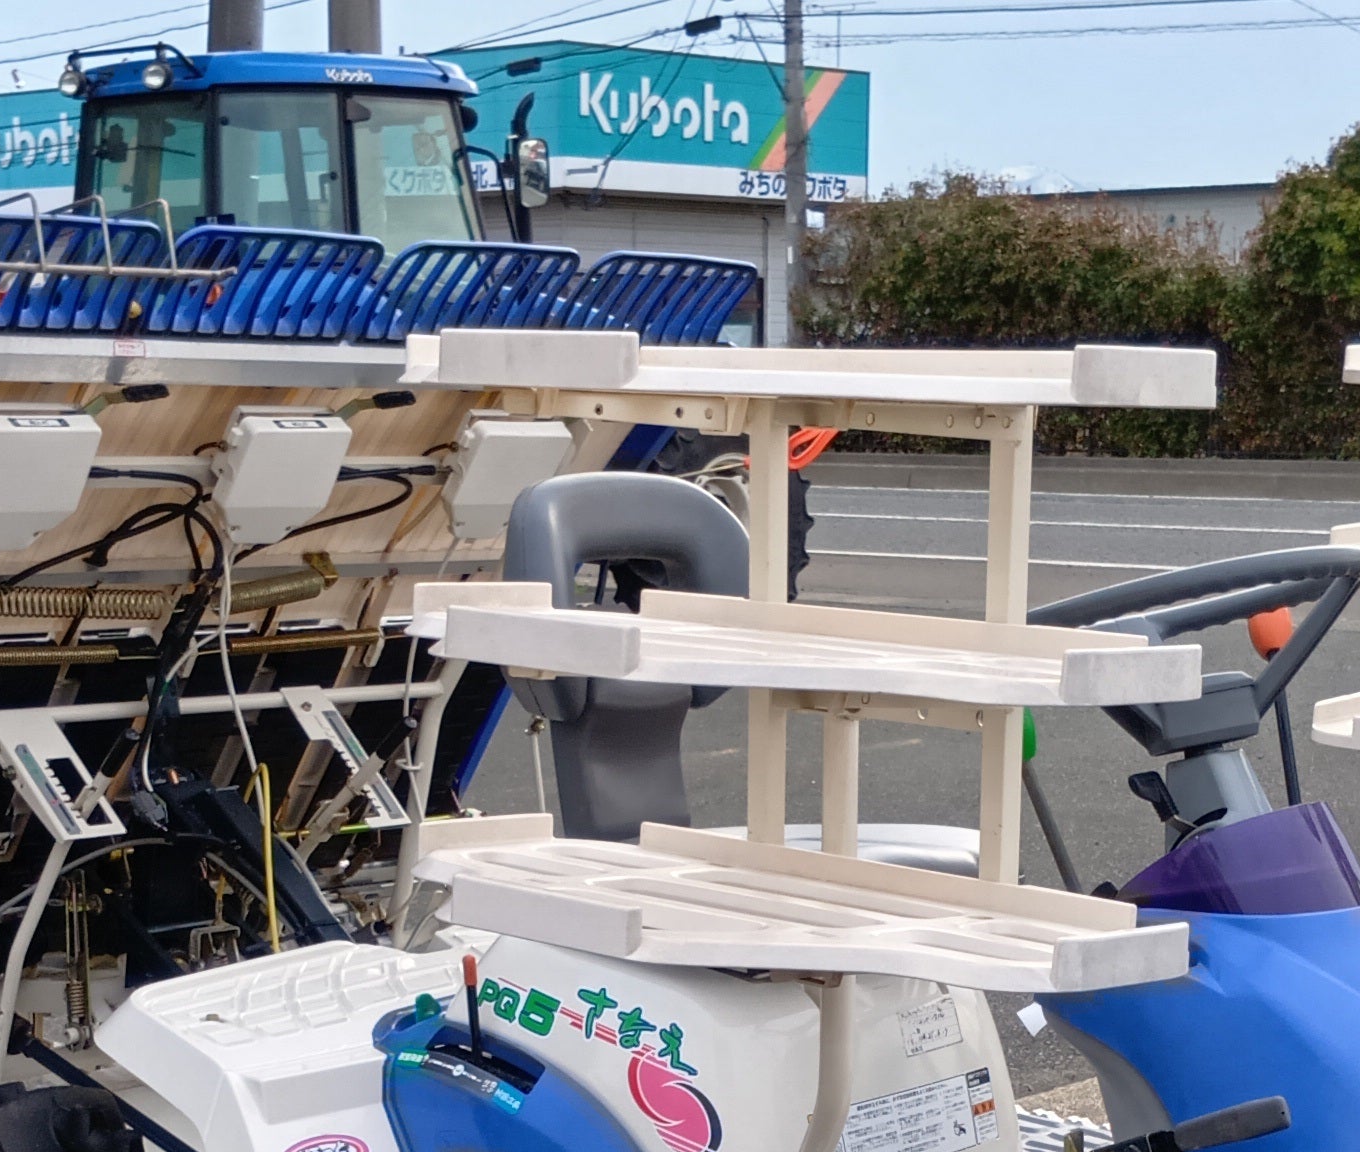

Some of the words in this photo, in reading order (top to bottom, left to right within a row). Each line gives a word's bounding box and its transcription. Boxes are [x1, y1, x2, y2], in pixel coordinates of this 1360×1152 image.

[325, 67, 373, 82] Kubota
[579, 71, 750, 145] Kubota
[739, 171, 846, 200] みちのクボタ
[479, 978, 561, 1036] PQ5
[578, 987, 699, 1076] さなえ
